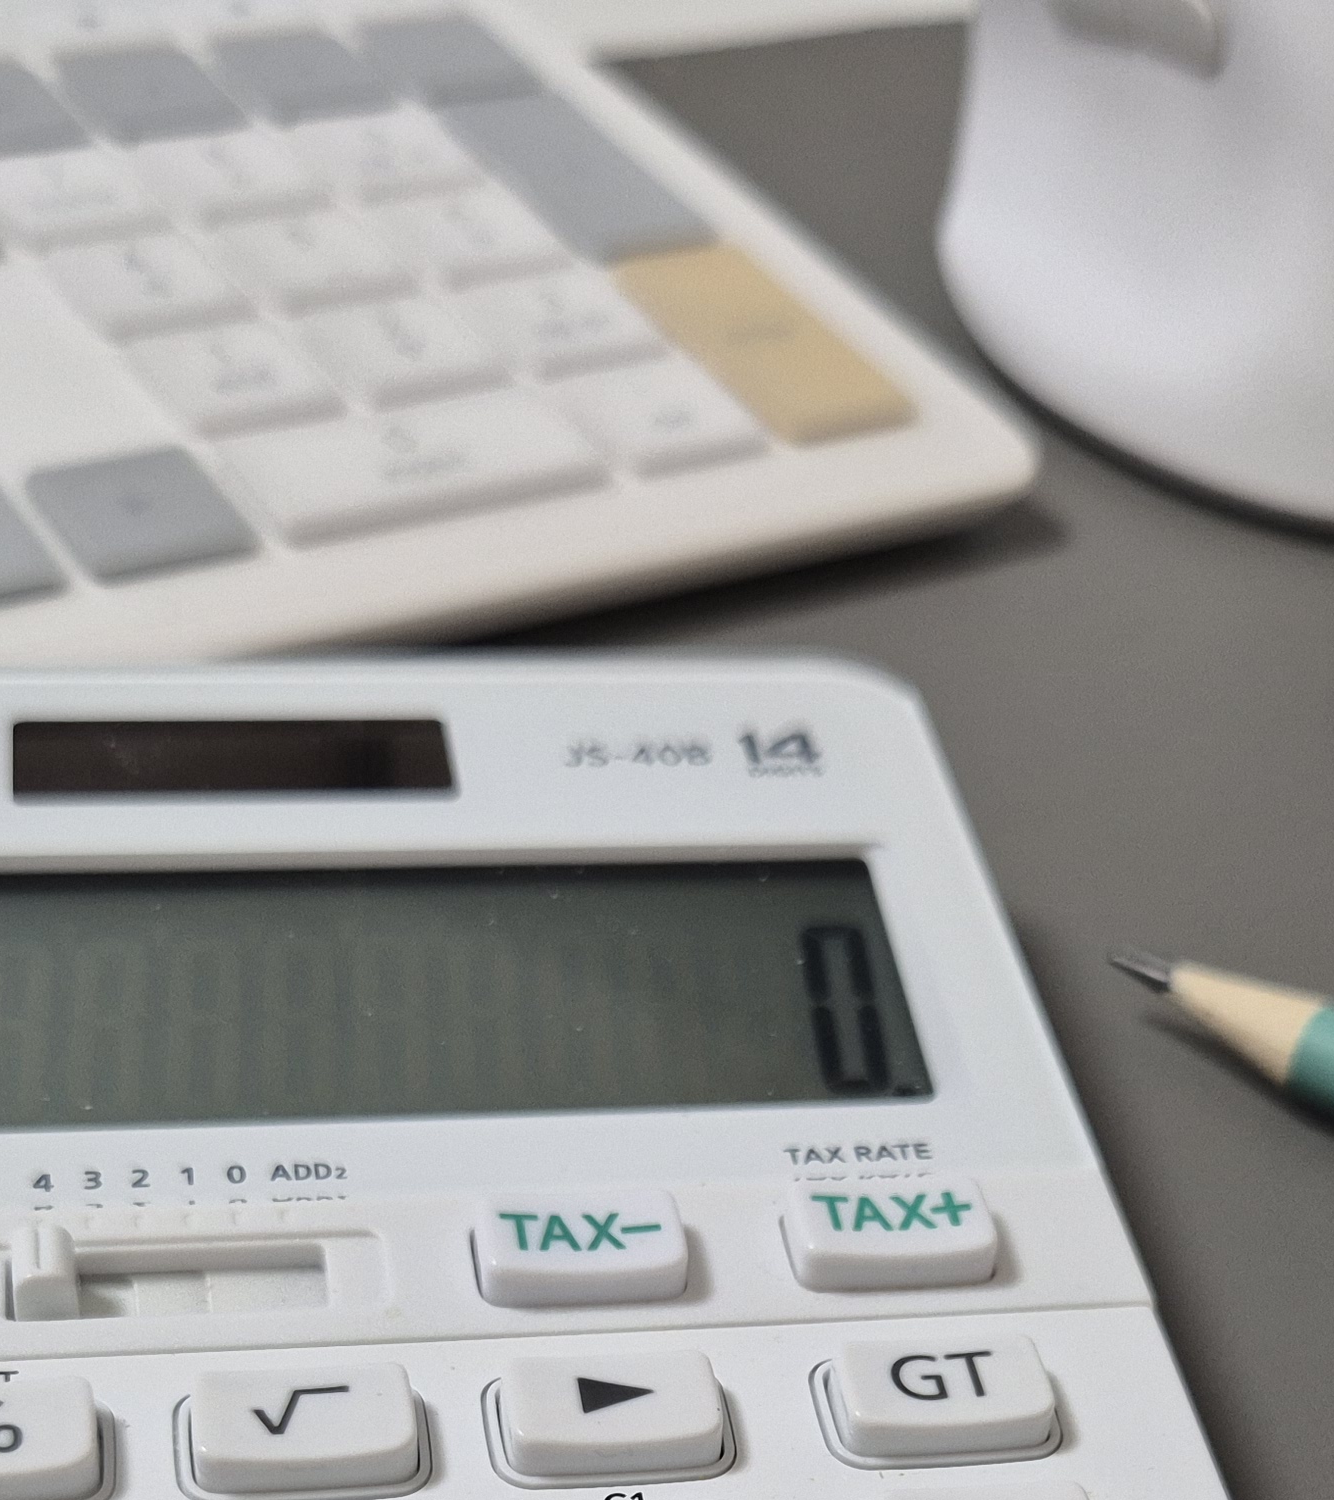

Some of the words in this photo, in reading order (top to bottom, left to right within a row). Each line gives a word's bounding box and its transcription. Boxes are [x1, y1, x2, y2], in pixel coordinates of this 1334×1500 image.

[738, 730, 821, 765] 14
[784, 1146, 845, 1165] TAX
[853, 1141, 932, 1162] RATE
[32, 1173, 53, 1192] 4
[83, 1169, 102, 1191] 3
[131, 1168, 150, 1189] 2
[180, 1166, 194, 1186] 1
[225, 1164, 247, 1184] 0
[810, 1190, 972, 1232] TAX+
[889, 1350, 992, 1402] GT
